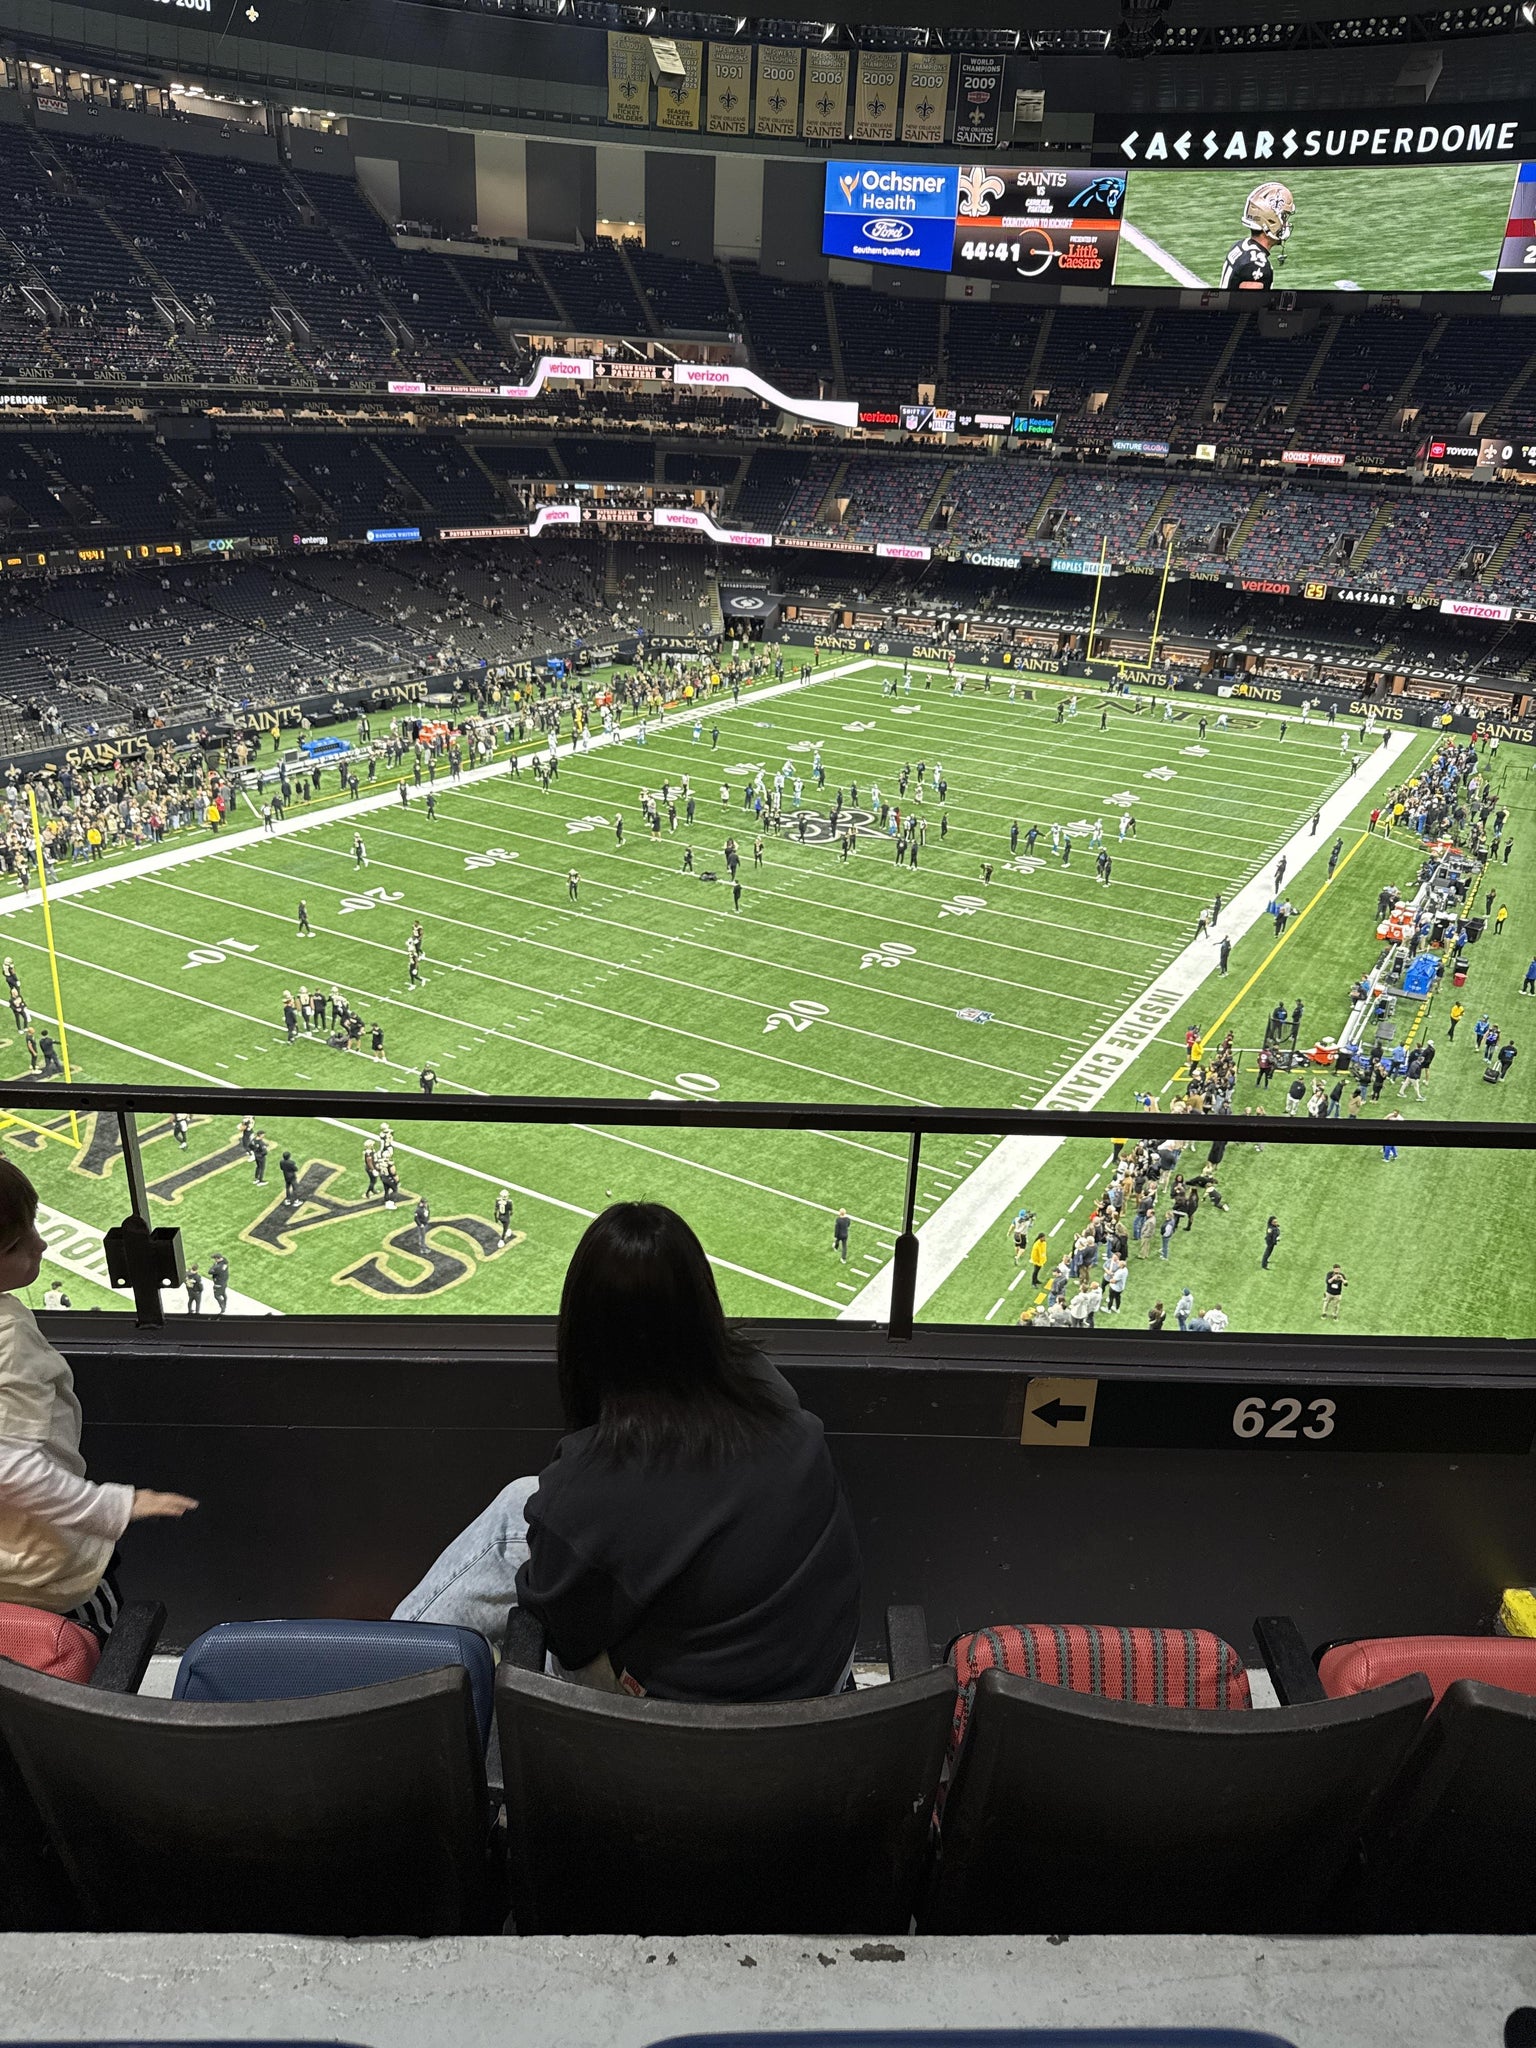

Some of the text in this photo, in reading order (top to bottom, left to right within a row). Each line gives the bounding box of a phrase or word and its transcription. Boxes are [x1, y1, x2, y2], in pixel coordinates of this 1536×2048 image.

[970, 57, 995, 66] WORLD
[716, 65, 743, 79] 1991
[763, 67, 795, 81] 2000
[962, 64, 1001, 73] CHAMPIONS
[811, 71, 843, 84] 2006
[863, 72, 894, 85] 2009
[911, 75, 944, 88] 2009
[964, 77, 996, 90] 2009
[709, 120, 746, 133] SAINTS
[757, 121, 794, 134] SAINTS
[805, 125, 842, 137] SAINTS
[856, 126, 893, 139] SAINTS
[904, 129, 941, 142] SAINTS
[956, 131, 993, 143] SAINTS
[1120, 121, 1519, 160] CAESARS SUPERDOME
[862, 170, 946, 193] Ochsner
[1016, 172, 1067, 188] SAINTS
[1036, 186, 1046, 197] VS
[862, 193, 916, 211] Health
[1001, 217, 1074, 229] COUNTDOWN TO KICKOFF
[871, 221, 904, 239] Ford
[852, 246, 921, 257] Southern Quality Ford
[961, 241, 1021, 262] 44:41
[1068, 243, 1099, 258] Little
[1058, 254, 1103, 270] Caesars
[19, 368, 54, 379] SAINTS
[94, 371, 127, 381] SAINTS
[163, 373, 194, 382] SAINTS
[611, 369, 656, 379] PARTNERS
[687, 370, 730, 383] verizon
[229, 376, 259, 385] SAINTS
[290, 378, 318, 388] SAINTS
[350, 381, 376, 389] SAINTS
[393, 384, 420, 393] verizon
[0, 396, 48, 405] UPERDOME
[859, 410, 898, 425] verizon
[1028, 418, 1055, 427] Keesler
[1028, 425, 1054, 434] Federal
[1113, 441, 1169, 453] VENTURE GLOBAL
[1446, 446, 1478, 457] TOYOTA
[1501, 445, 1513, 460] 0
[1282, 452, 1345, 465] ROUSES MARKETS
[1355, 455, 1385, 465] SAINTS
[667, 514, 698, 526] verizon
[208, 539, 234, 551] COX
[301, 536, 328, 546] entergy
[729, 534, 765, 546] verizon
[887, 547, 923, 559] verizon
[972, 553, 1020, 569] Ochsner
[1053, 560, 1083, 573] PEOPLES
[1125, 565, 1155, 575] SAINTS
[1190, 572, 1220, 582] SAINTS
[1242, 580, 1291, 595] verizon
[1307, 584, 1324, 597] 25
[1337, 590, 1396, 606] CAESARS
[1406, 595, 1440, 607] SAINTS
[1453, 604, 1502, 619] verizon
[881, 606, 1105, 636] CAESARS SUPERDOME
[813, 635, 857, 651] SAINTS
[912, 646, 956, 660] SAINTS
[1014, 657, 1059, 673] SAINTS
[1216, 642, 1480, 684] CAESARS SUPERDOME
[1121, 669, 1168, 687] SAINTS
[1350, 701, 1404, 721] SAINTS
[234, 704, 302, 733] SAINTS
[1475, 722, 1534, 743] SAINTS
[65, 735, 151, 767] SAINTS
[942, 895, 987, 917] 40
[862, 942, 917, 969] 30
[767, 1000, 830, 1033] 20
[1103, 987, 1184, 1051] INSPIRE
[1232, 1397, 1337, 1440] 623
